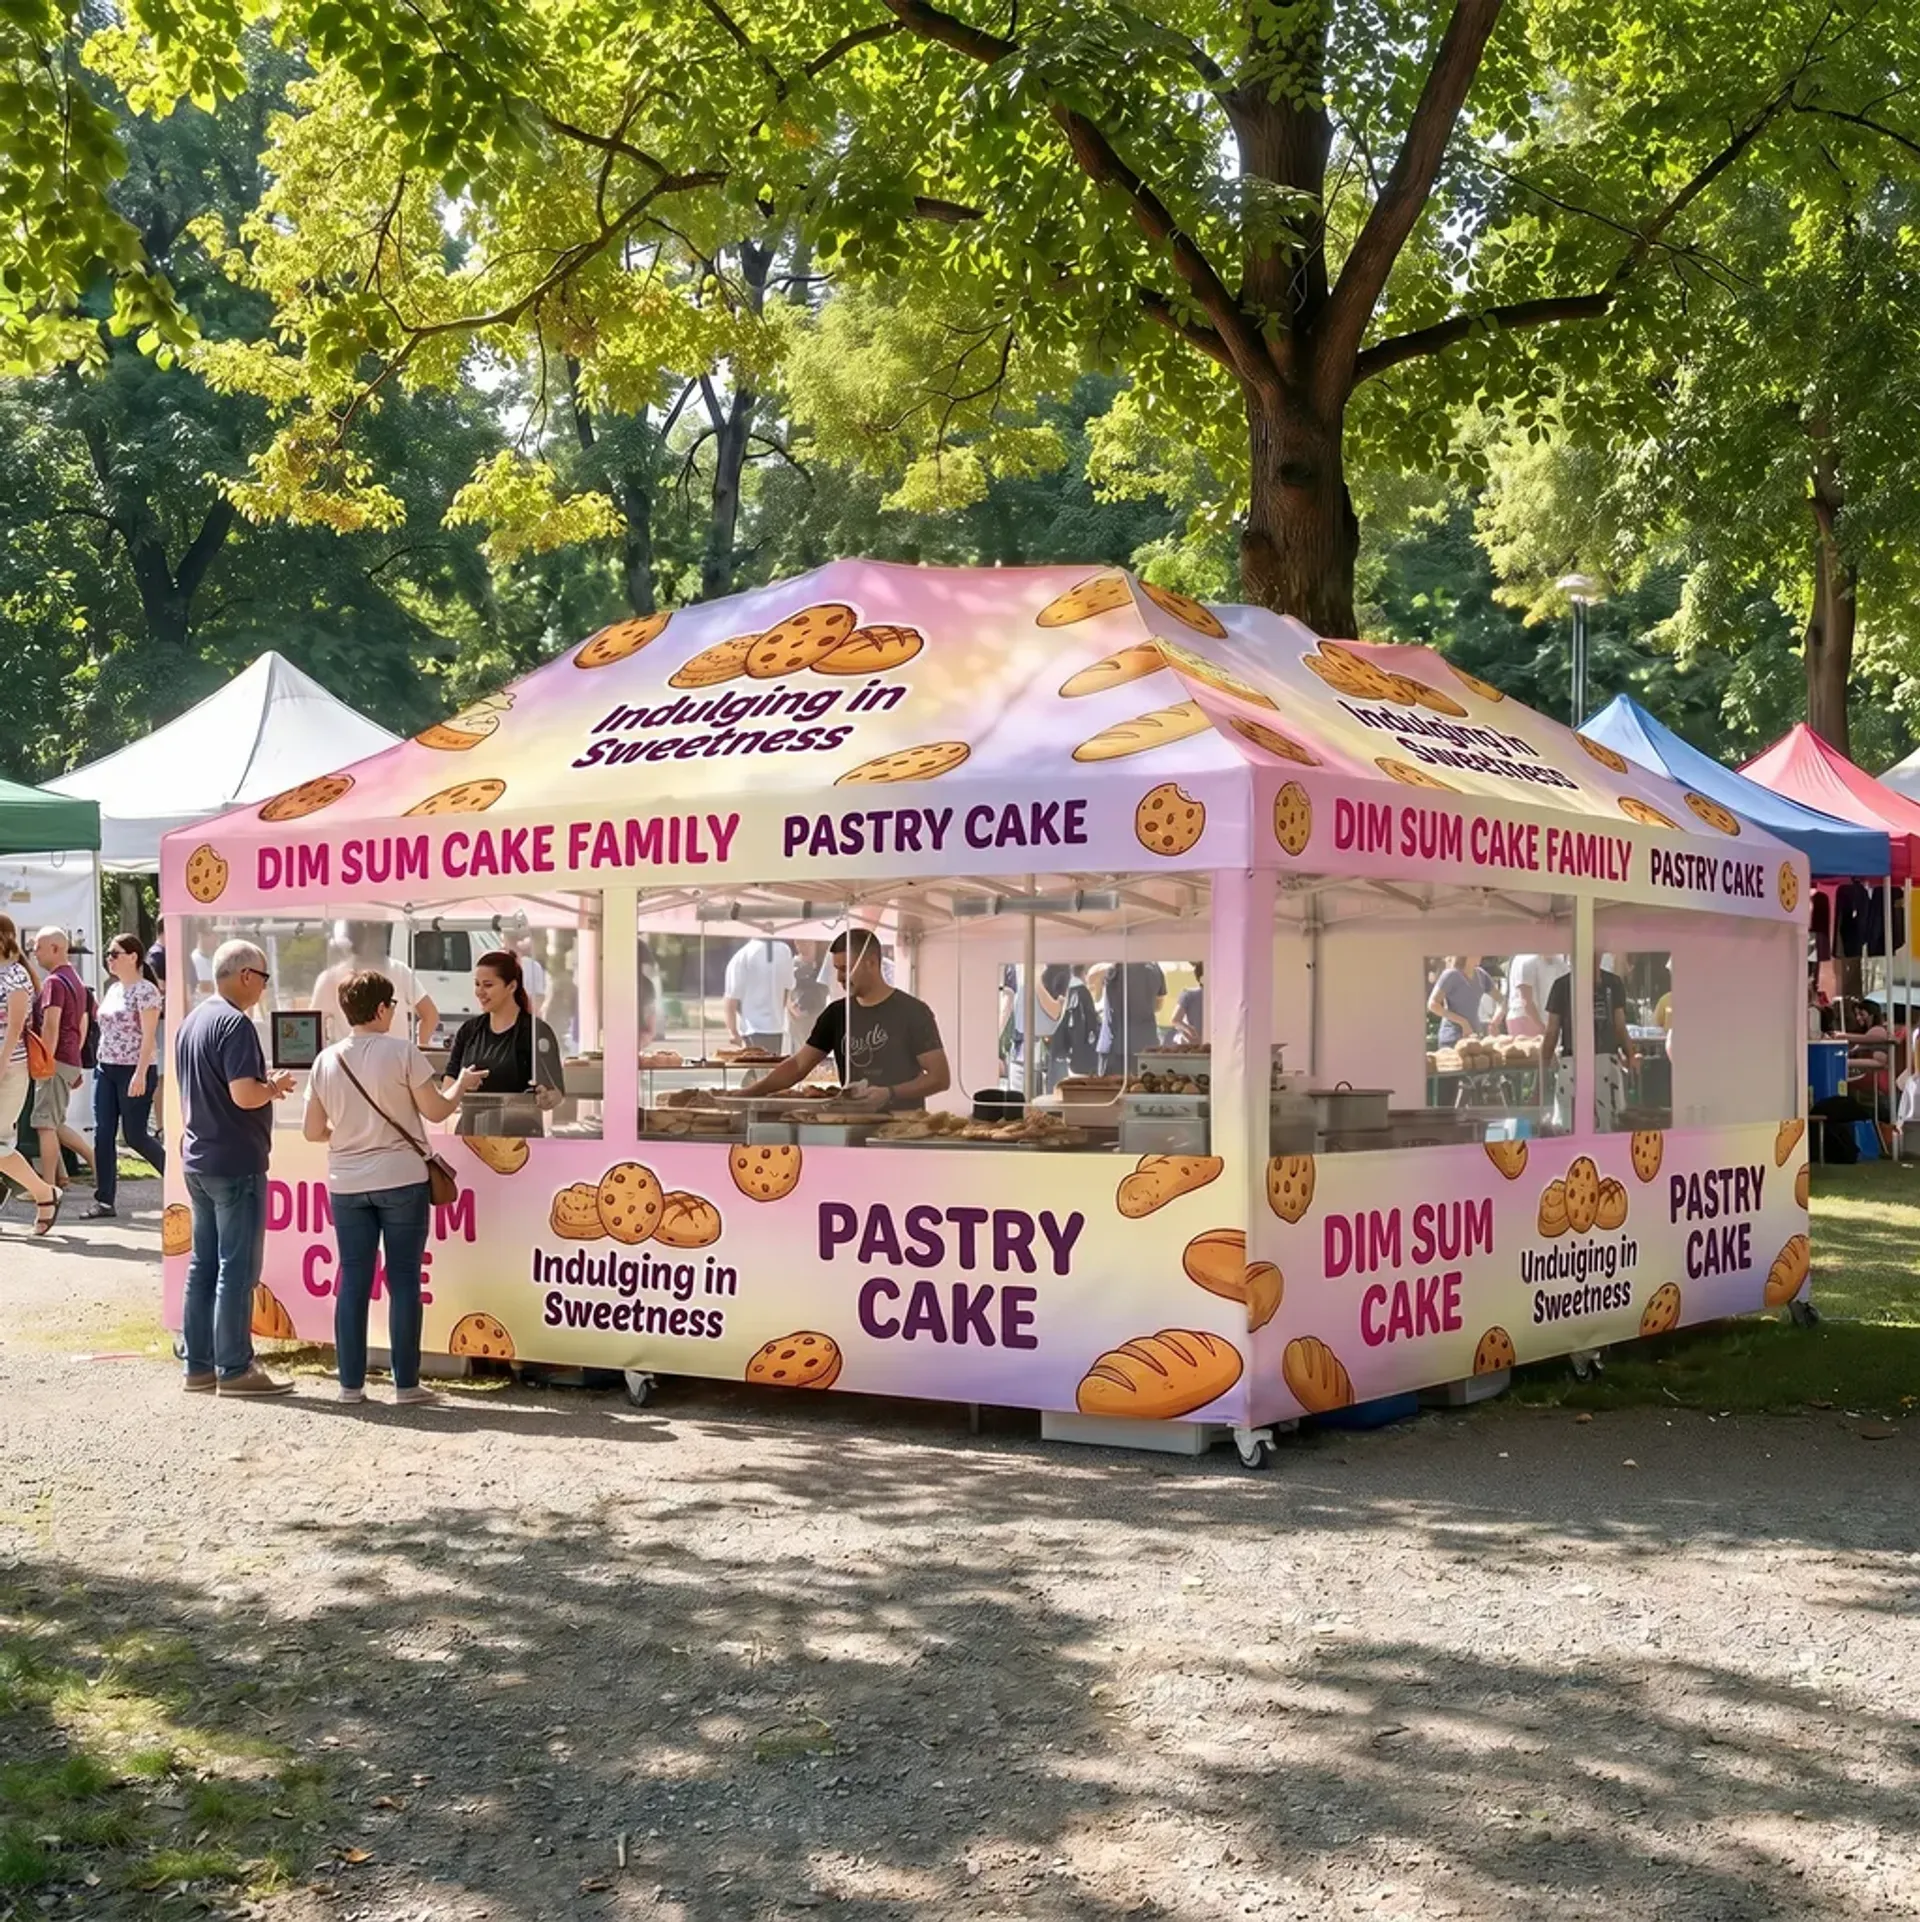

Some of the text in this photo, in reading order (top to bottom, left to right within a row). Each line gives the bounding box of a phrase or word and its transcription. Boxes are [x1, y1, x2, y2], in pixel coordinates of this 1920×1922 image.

[591, 679, 907, 734] Indulging in
[572, 722, 854, 768] Sweetness
[1396, 736, 1579, 790] Sweetness
[257, 813, 740, 890] DIM SUM CAKE FAMILY
[784, 799, 1088, 858] PASTRY CAKE
[1334, 797, 1632, 882] DIM SUM CAKE FAMILY
[1650, 848, 1765, 899] PASTRY CAKE
[1670, 1165, 1766, 1224] PASTRY
[818, 1201, 1085, 1276] PASTRY
[1324, 1197, 1494, 1279] DIM SUM
[1620, 1233, 1638, 1268] in
[1686, 1222, 1753, 1281] CAKE
[532, 1248, 738, 1301] Indulging in
[1533, 1280, 1631, 1324] Sweetness
[543, 1291, 725, 1339] Sweetness
[858, 1277, 1039, 1350] CAKE
[1360, 1271, 1463, 1347] CAKE
